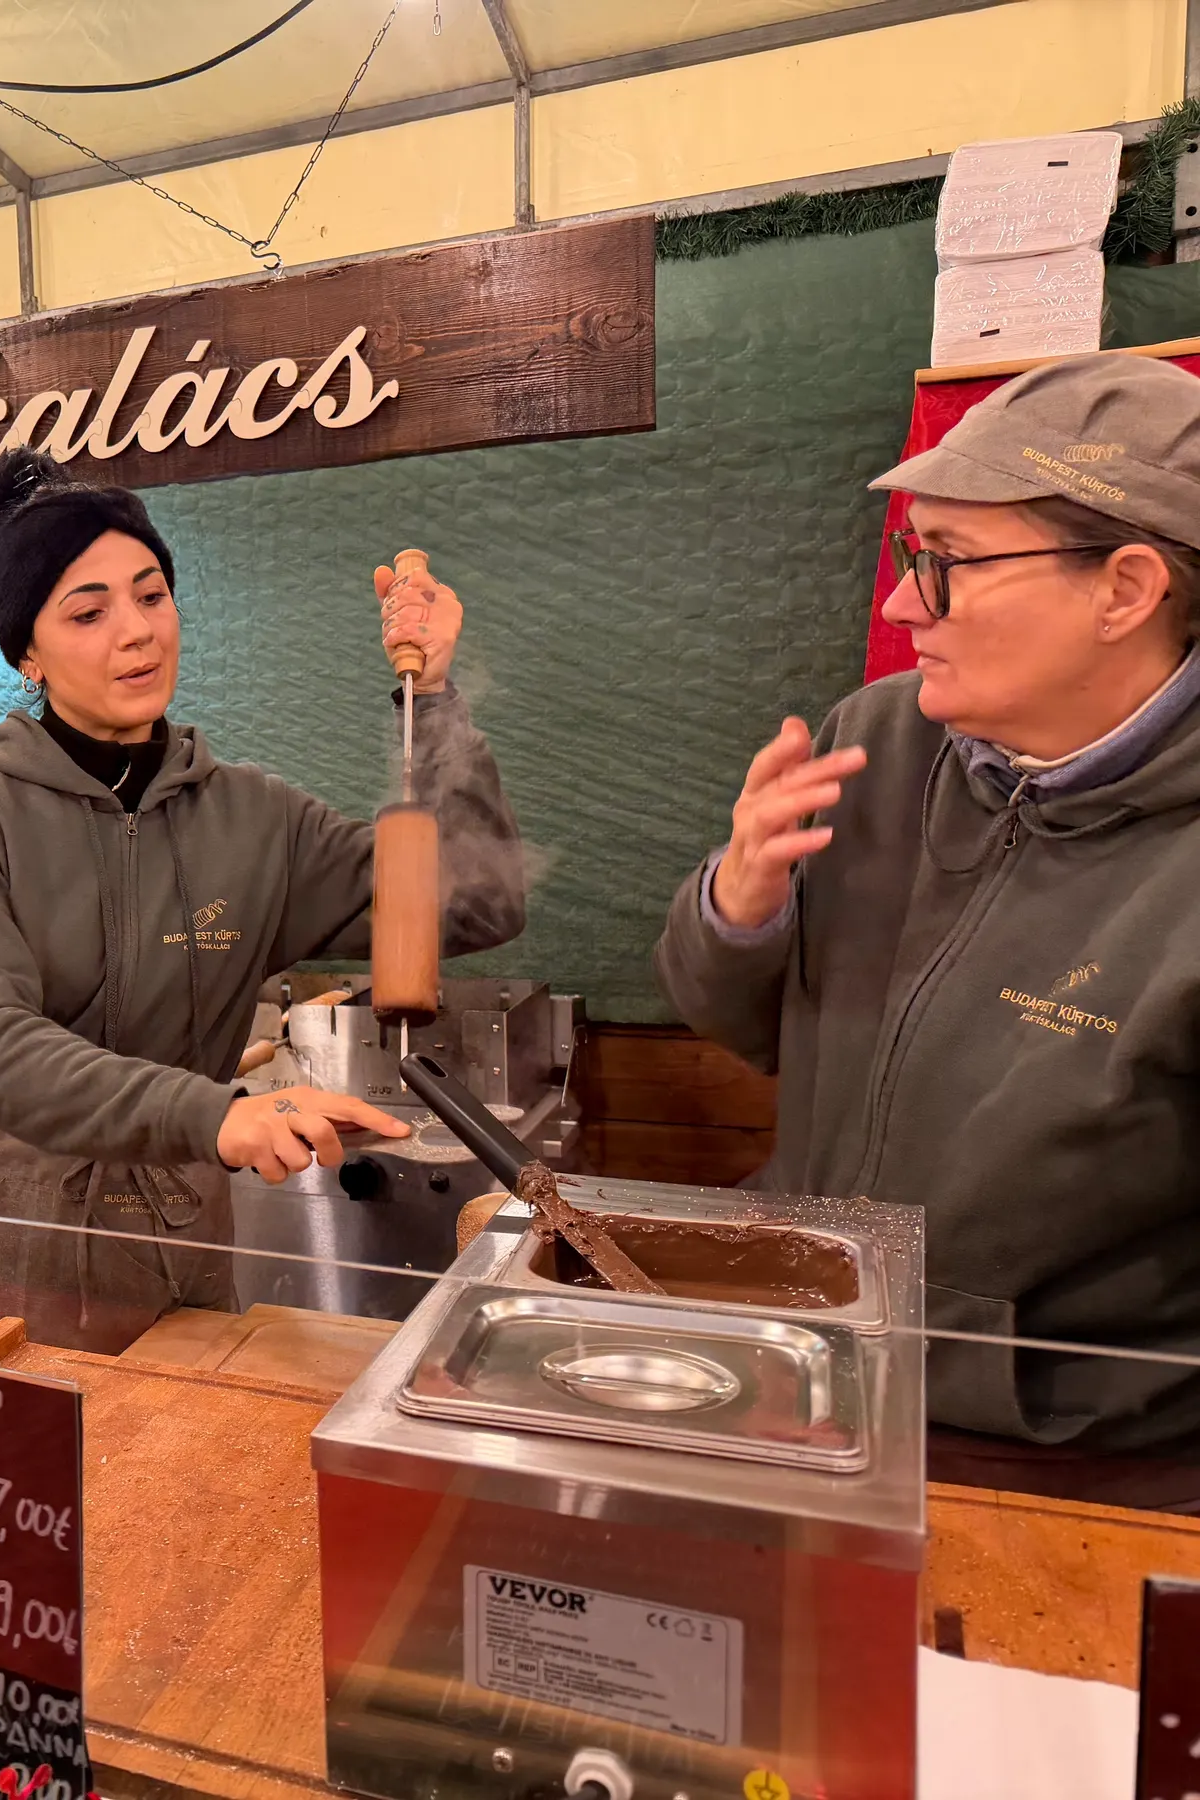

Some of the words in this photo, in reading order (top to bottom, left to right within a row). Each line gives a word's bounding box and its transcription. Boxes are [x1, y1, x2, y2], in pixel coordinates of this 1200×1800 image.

[1022, 447, 1080, 479] BUDAPEST
[163, 931, 213, 943] BUDAEST
[1057, 1004, 1117, 1034] KÜRTÖS
[489, 1576, 587, 1614] VEVOR
